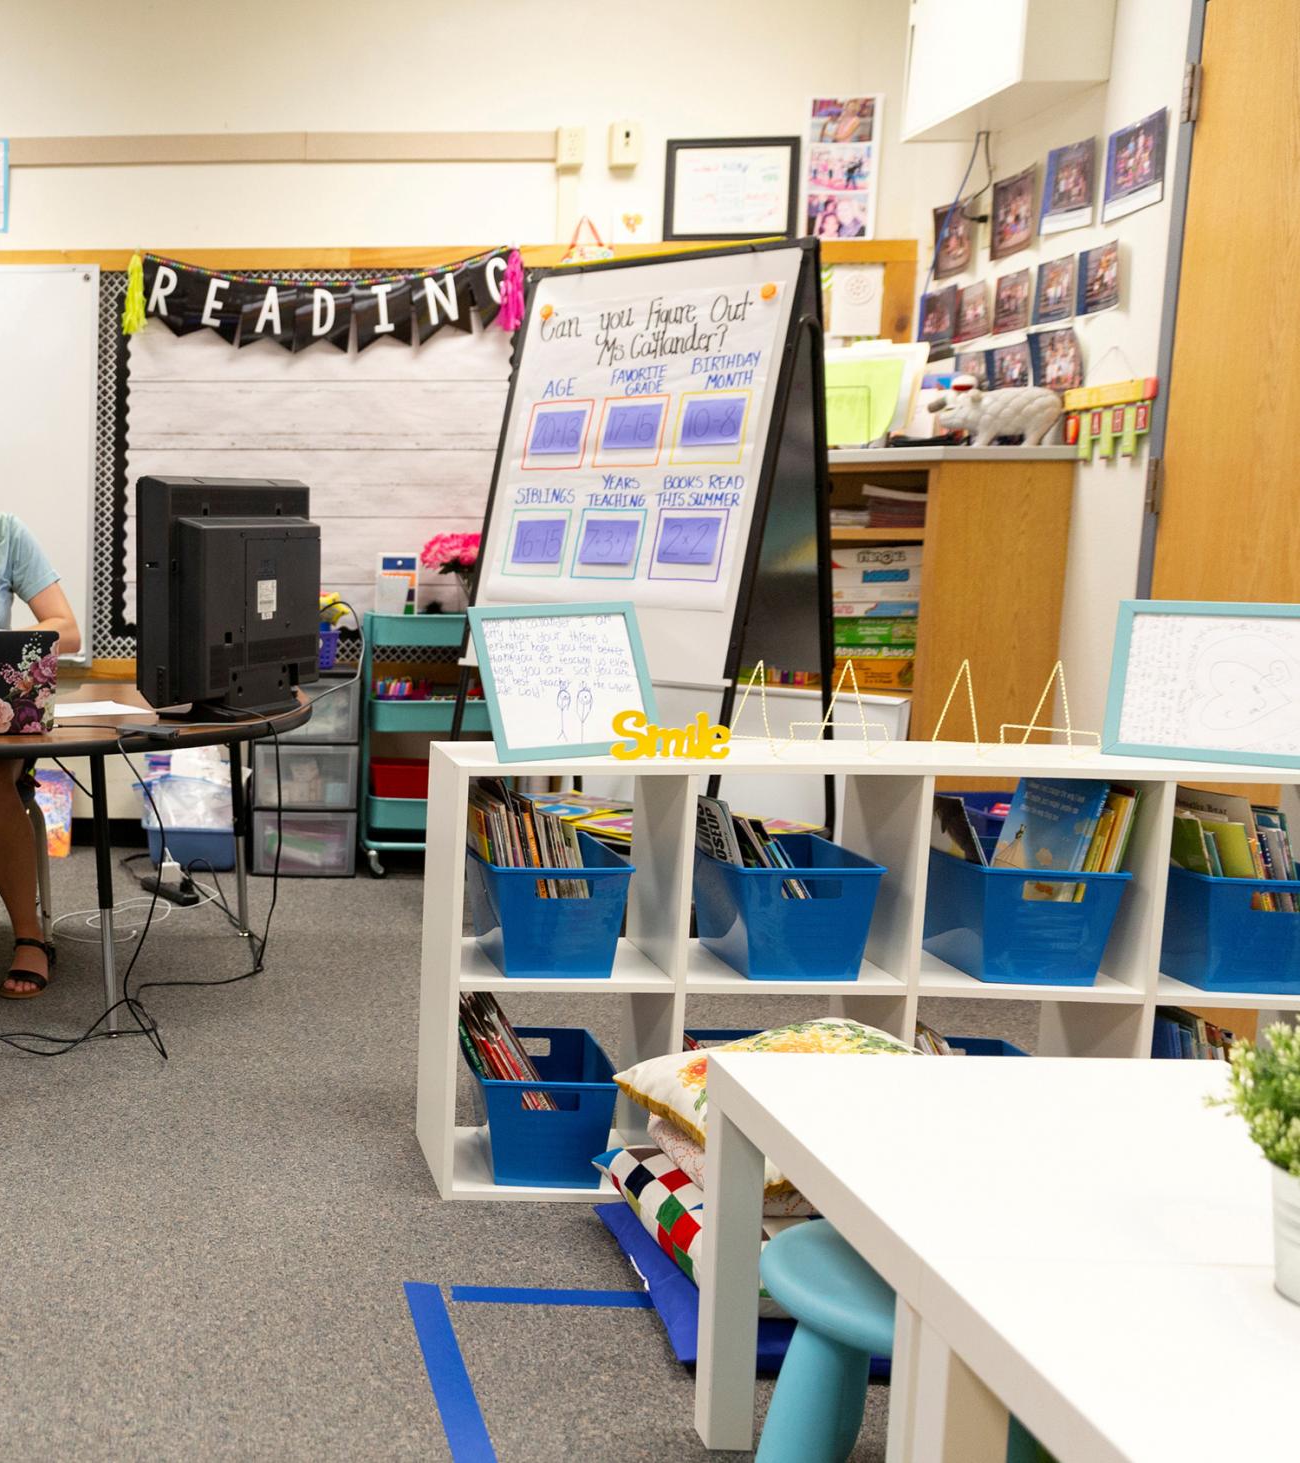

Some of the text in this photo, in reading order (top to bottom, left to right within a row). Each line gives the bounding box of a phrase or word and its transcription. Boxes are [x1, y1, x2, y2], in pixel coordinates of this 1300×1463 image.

[540, 311, 581, 342] Can
[710, 291, 754, 323] Out
[691, 351, 761, 376] BIRTHDAY
[610, 364, 668, 386] FAVORITE
[704, 370, 754, 390] MONTH
[542, 377, 578, 398] AGE
[625, 380, 663, 396] GRADE
[601, 474, 641, 489] YEARS
[663, 474, 744, 490] BOOKS READ
[515, 487, 575, 505] SIBLINGS
[586, 493, 646, 508] TEACHING
[655, 491, 741, 508] THIS SUMMER
[835, 646, 914, 657] ADDITION BINGO
[611, 710, 731, 760] Smile
